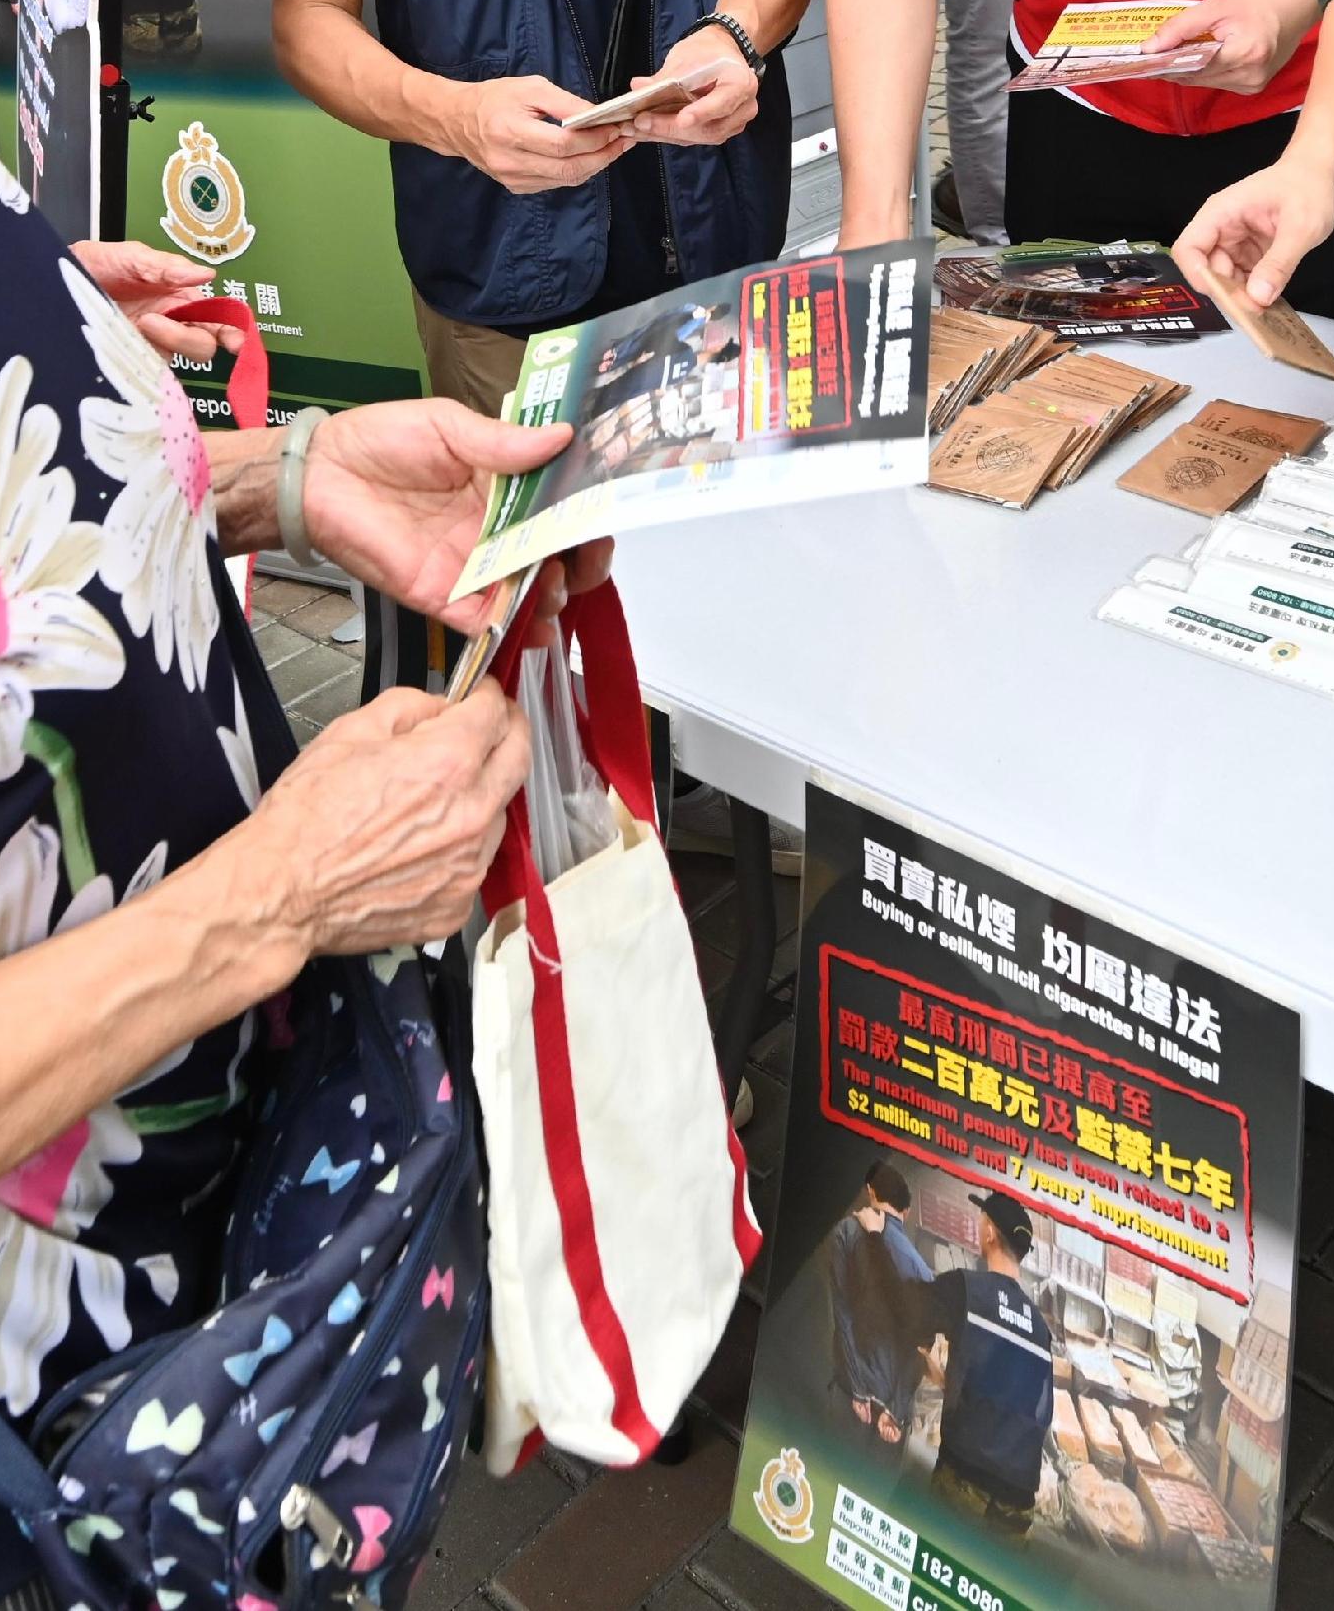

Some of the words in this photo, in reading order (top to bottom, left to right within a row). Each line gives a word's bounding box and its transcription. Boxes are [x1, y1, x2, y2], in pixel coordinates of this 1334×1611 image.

[862, 889, 914, 933] Buying
[917, 920, 936, 940] or
[939, 931, 993, 974] selling
[997, 955, 1040, 994] illicit
[1043, 982, 1134, 1041] cigarettes
[1138, 1025, 1156, 1053] is
[1159, 1036, 1220, 1084] illegal
[863, 836, 1016, 953] 買賣私煙
[1042, 923, 1222, 1054] 均屬違法
[838, 1007, 1236, 1212] 罰款二百萬元及監禁七年
[842, 1058, 871, 1087] The
[874, 1075, 959, 1124] maximum
[963, 1111, 1029, 1158] penalty
[1032, 1136, 1068, 1172] has
[1071, 1154, 1119, 1194] been
[1122, 1179, 1186, 1223] raised
[1189, 1205, 1212, 1234] to
[1215, 1220, 1231, 1244] a
[898, 990, 1154, 1128] 最高刑罰已提高至
[847, 1087, 870, 1116] $2
[873, 1102, 932, 1140] million
[935, 1124, 969, 1157] fine
[972, 1144, 1007, 1174] and
[1008, 1155, 1023, 1180] 7
[1088, 1191, 1230, 1273] imprisonment
[832, 1554, 877, 1593] Reporting
[839, 1510, 881, 1550] Reporting
[880, 1538, 912, 1566] Hotline
[921, 1552, 954, 1588] 182
[957, 1575, 1004, 1611] 8080
